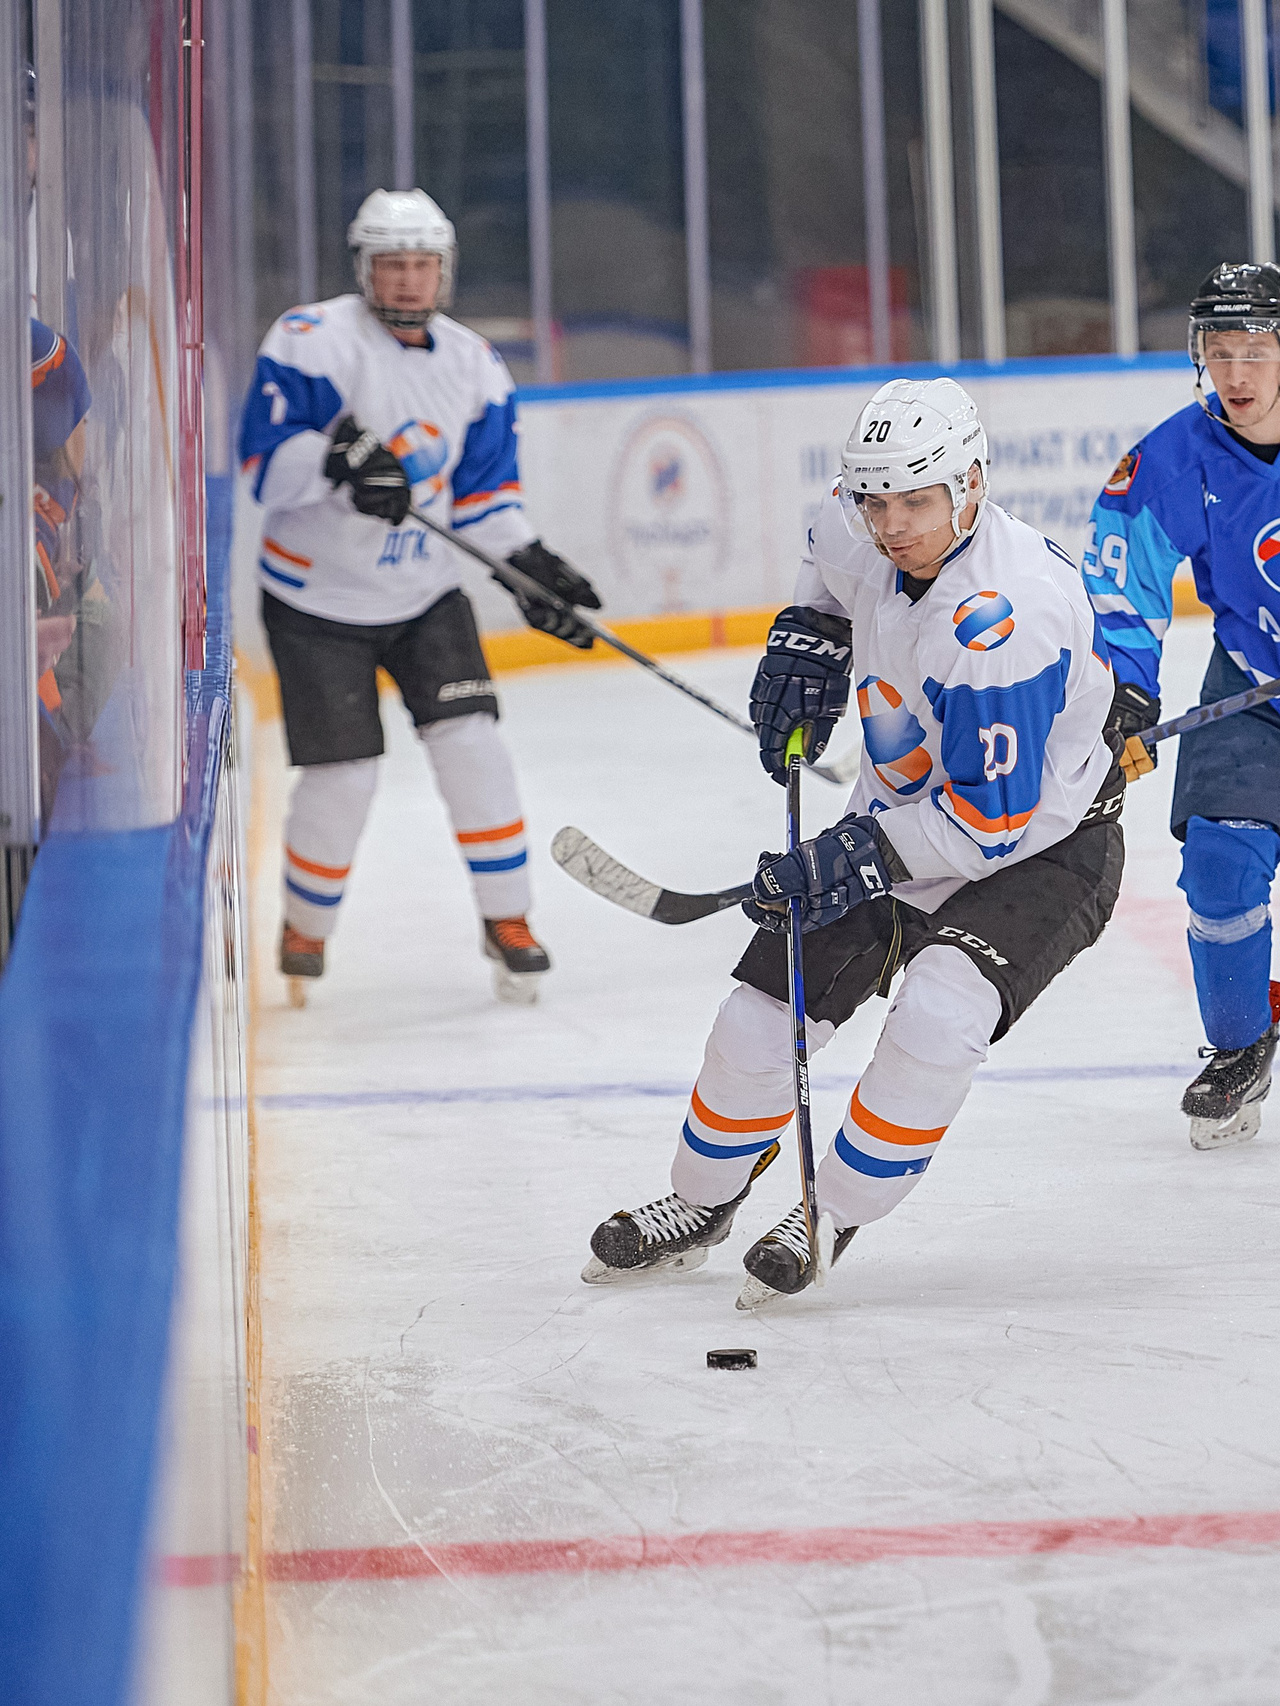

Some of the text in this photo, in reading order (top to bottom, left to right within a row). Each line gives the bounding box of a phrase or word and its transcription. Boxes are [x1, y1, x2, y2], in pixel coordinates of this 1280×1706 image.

[1213, 304, 1252, 312] BAUER
[863, 420, 891, 443] 20
[768, 630, 850, 661] CCM
[1081, 789, 1126, 821] CC
[937, 925, 1009, 966] CCM
[799, 1065, 809, 1106] SAPRO
